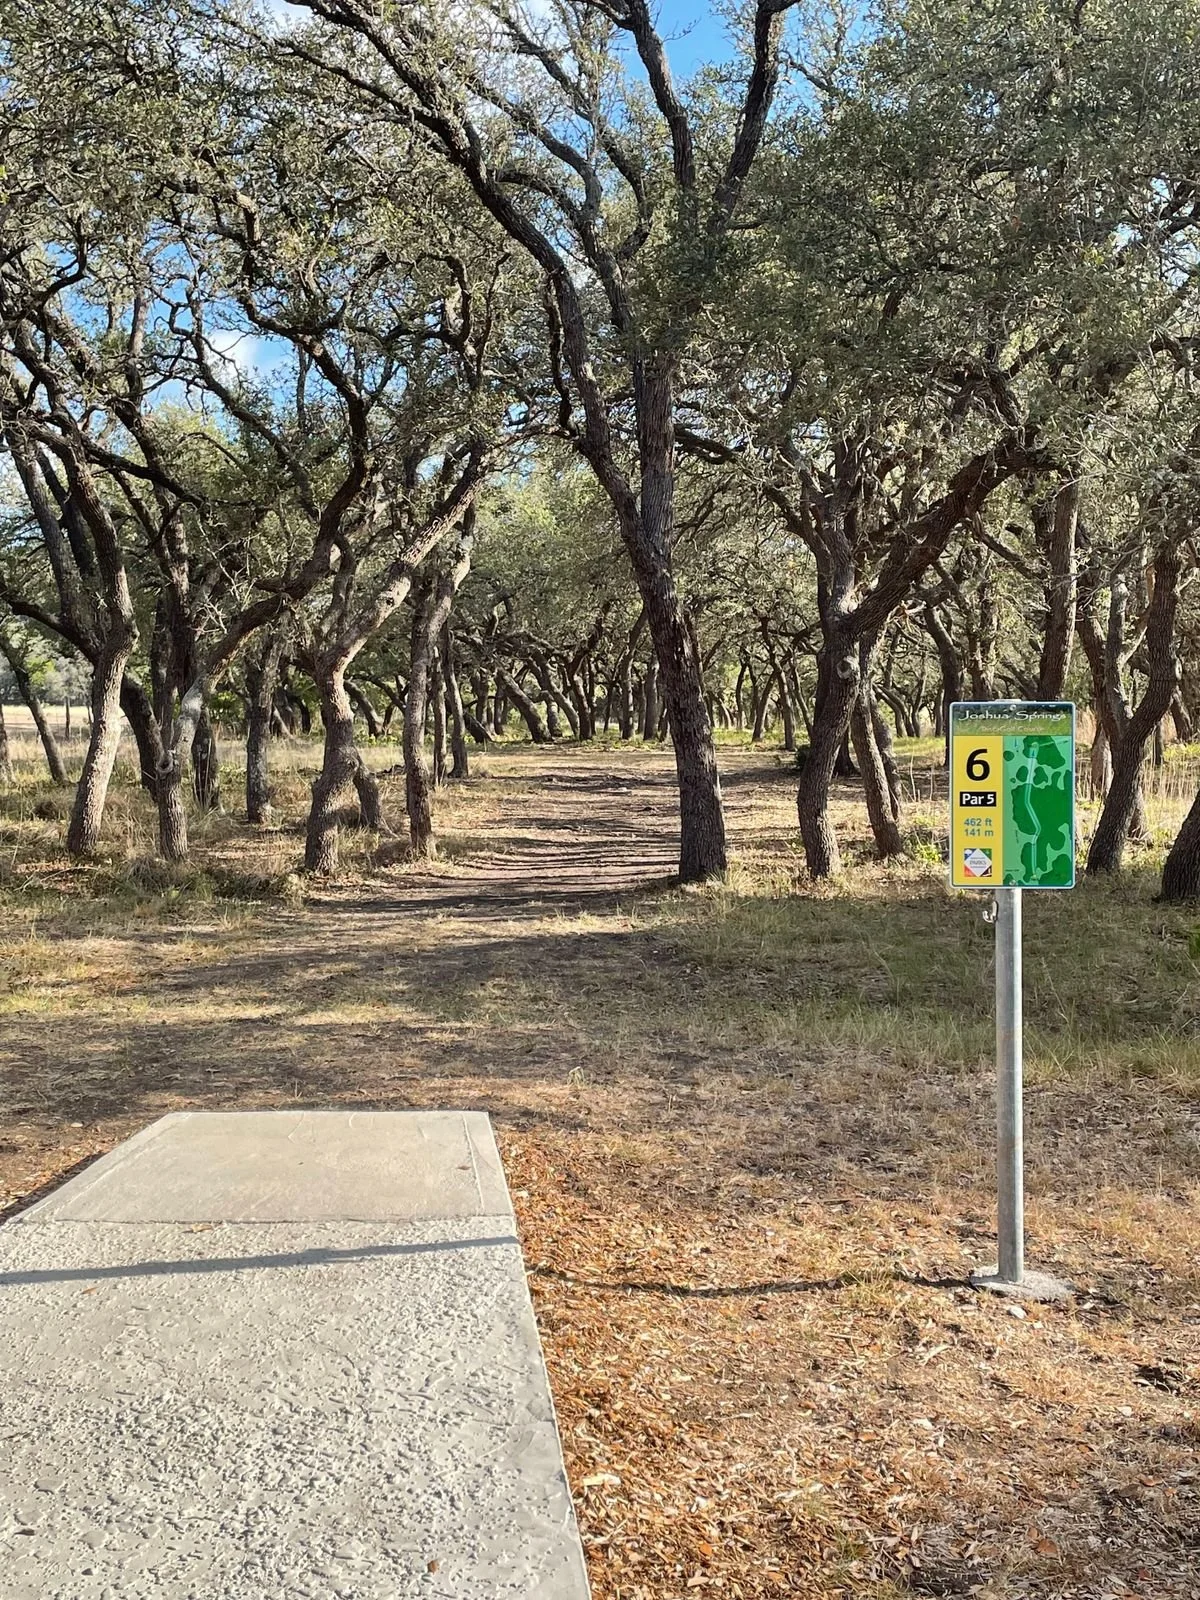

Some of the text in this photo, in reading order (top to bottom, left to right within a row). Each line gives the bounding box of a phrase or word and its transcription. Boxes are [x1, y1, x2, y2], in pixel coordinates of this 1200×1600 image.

[958, 710, 1067, 722] Joshua Springs
[966, 748, 990, 781] 6
[962, 793, 995, 805] Par 5
[964, 817, 992, 827] 462 ft
[964, 828, 994, 837] 141 m
